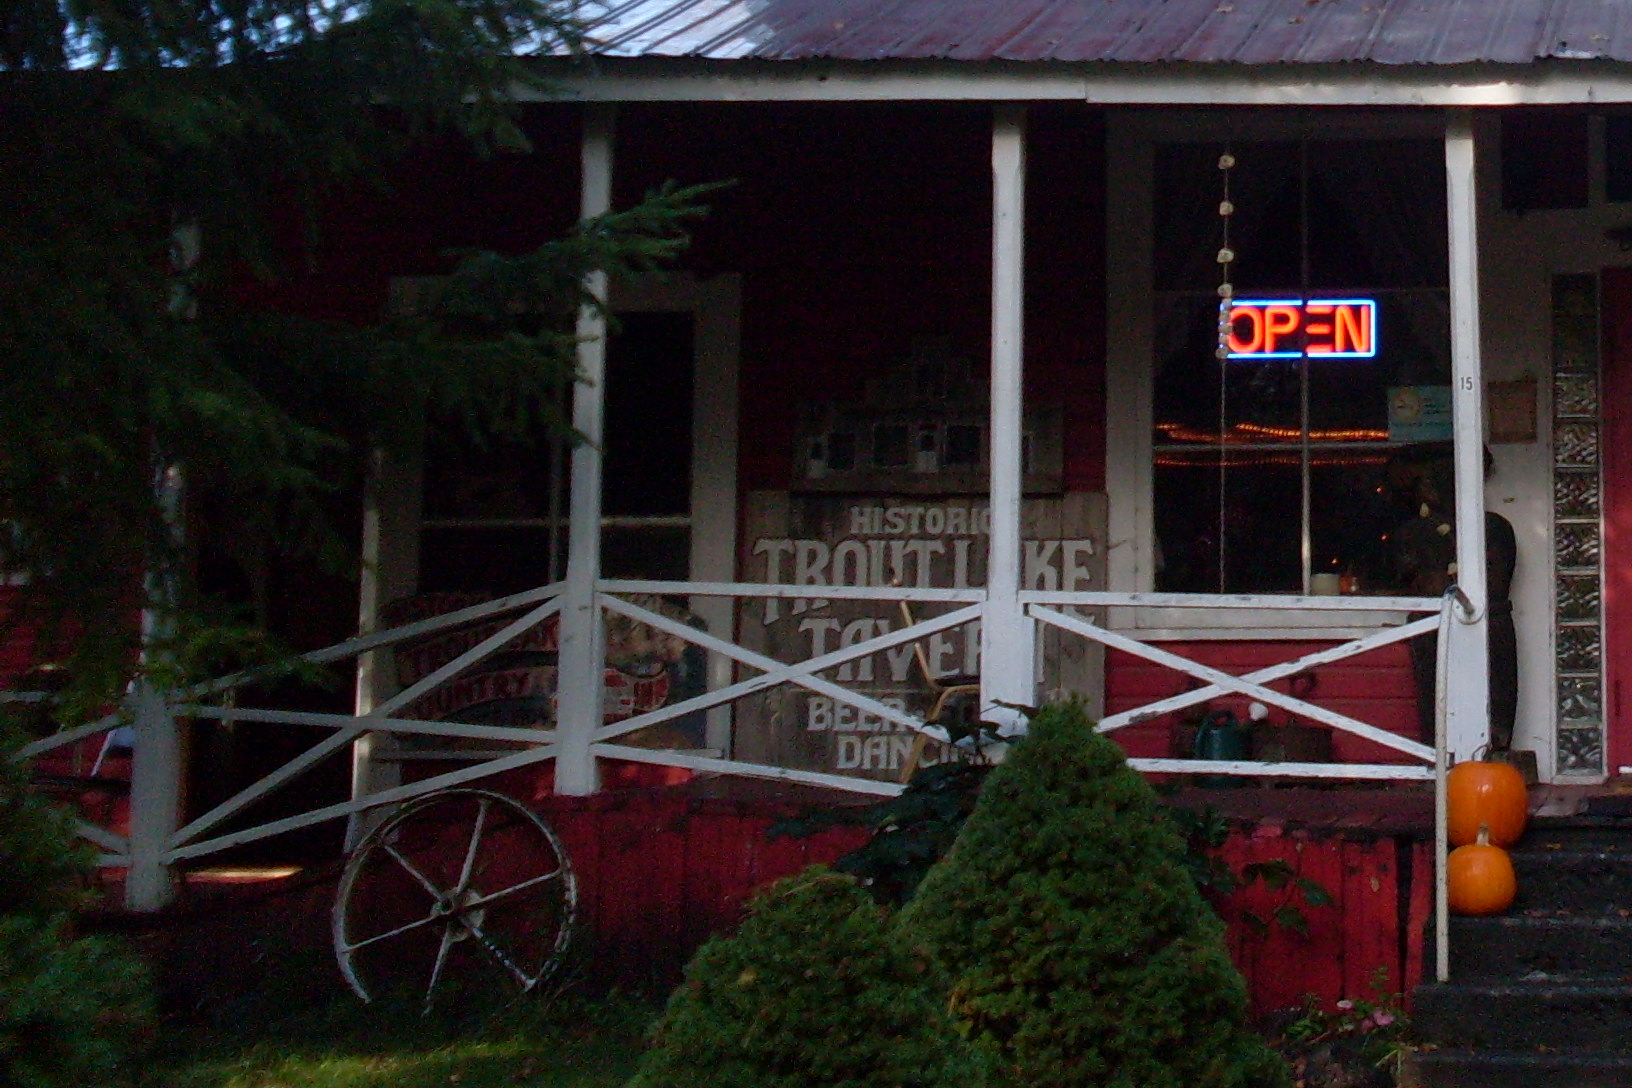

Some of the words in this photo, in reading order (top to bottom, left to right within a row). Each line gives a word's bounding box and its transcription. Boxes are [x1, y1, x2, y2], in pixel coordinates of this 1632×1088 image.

[1226, 305, 1371, 354] OPEN
[1460, 376, 1473, 391] 15
[851, 506, 991, 534] HISTORIC
[753, 538, 946, 625] TROUT
[953, 539, 1094, 625] LKE
[798, 618, 1045, 683] TAVE
